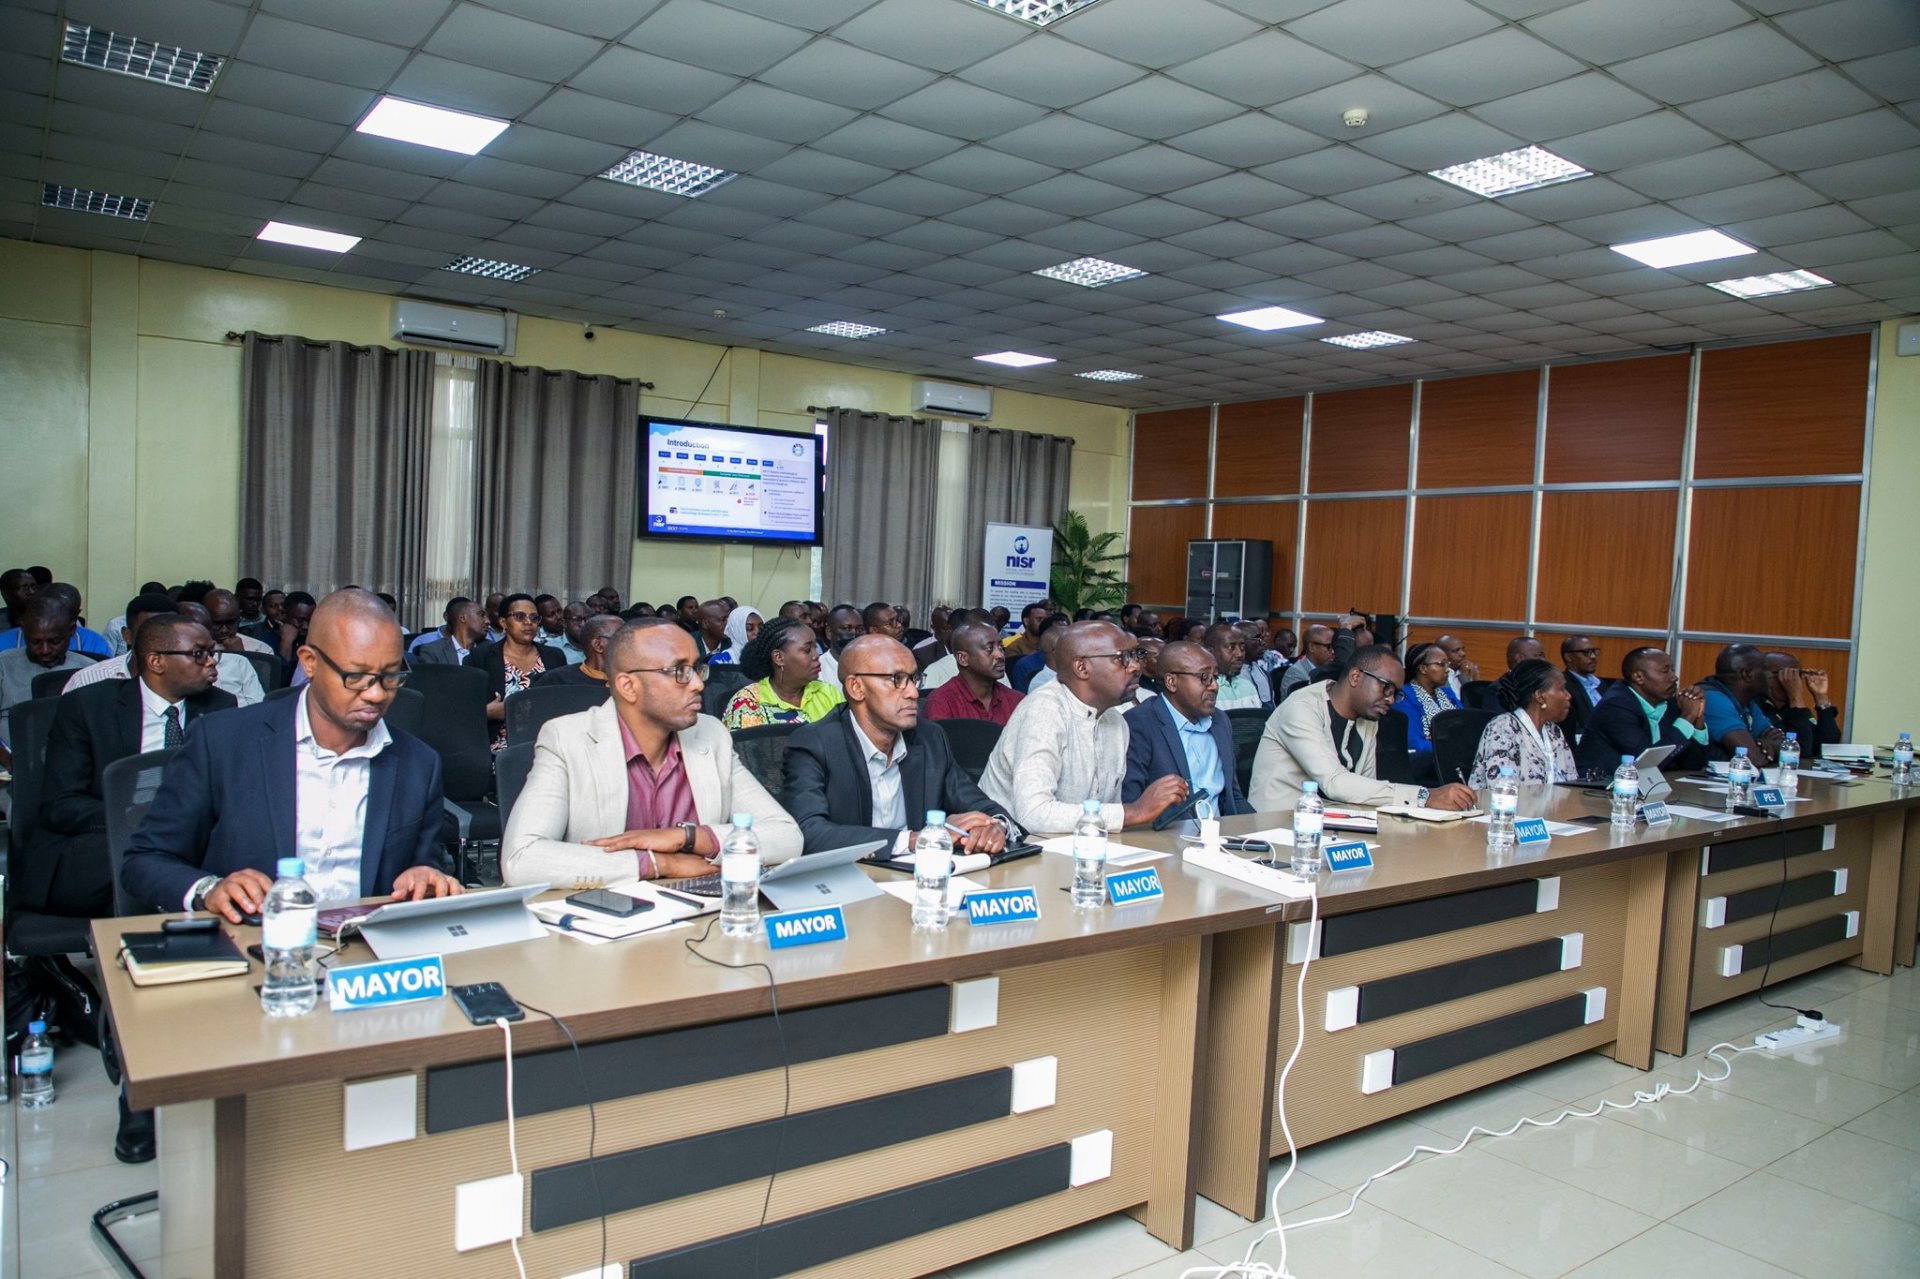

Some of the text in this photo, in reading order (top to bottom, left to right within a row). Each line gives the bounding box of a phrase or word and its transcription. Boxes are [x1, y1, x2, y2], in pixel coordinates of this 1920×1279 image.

[667, 438, 710, 450] Introduction
[1006, 555, 1035, 568] nisr
[1763, 792, 1777, 802] PES
[1516, 823, 1546, 838] MAYOR
[1331, 847, 1365, 862] MAYOR
[1114, 874, 1159, 897] MAYOR
[970, 895, 1036, 918] MAYOR
[774, 913, 837, 939] MAYOR
[337, 964, 443, 1001] MAYOR
